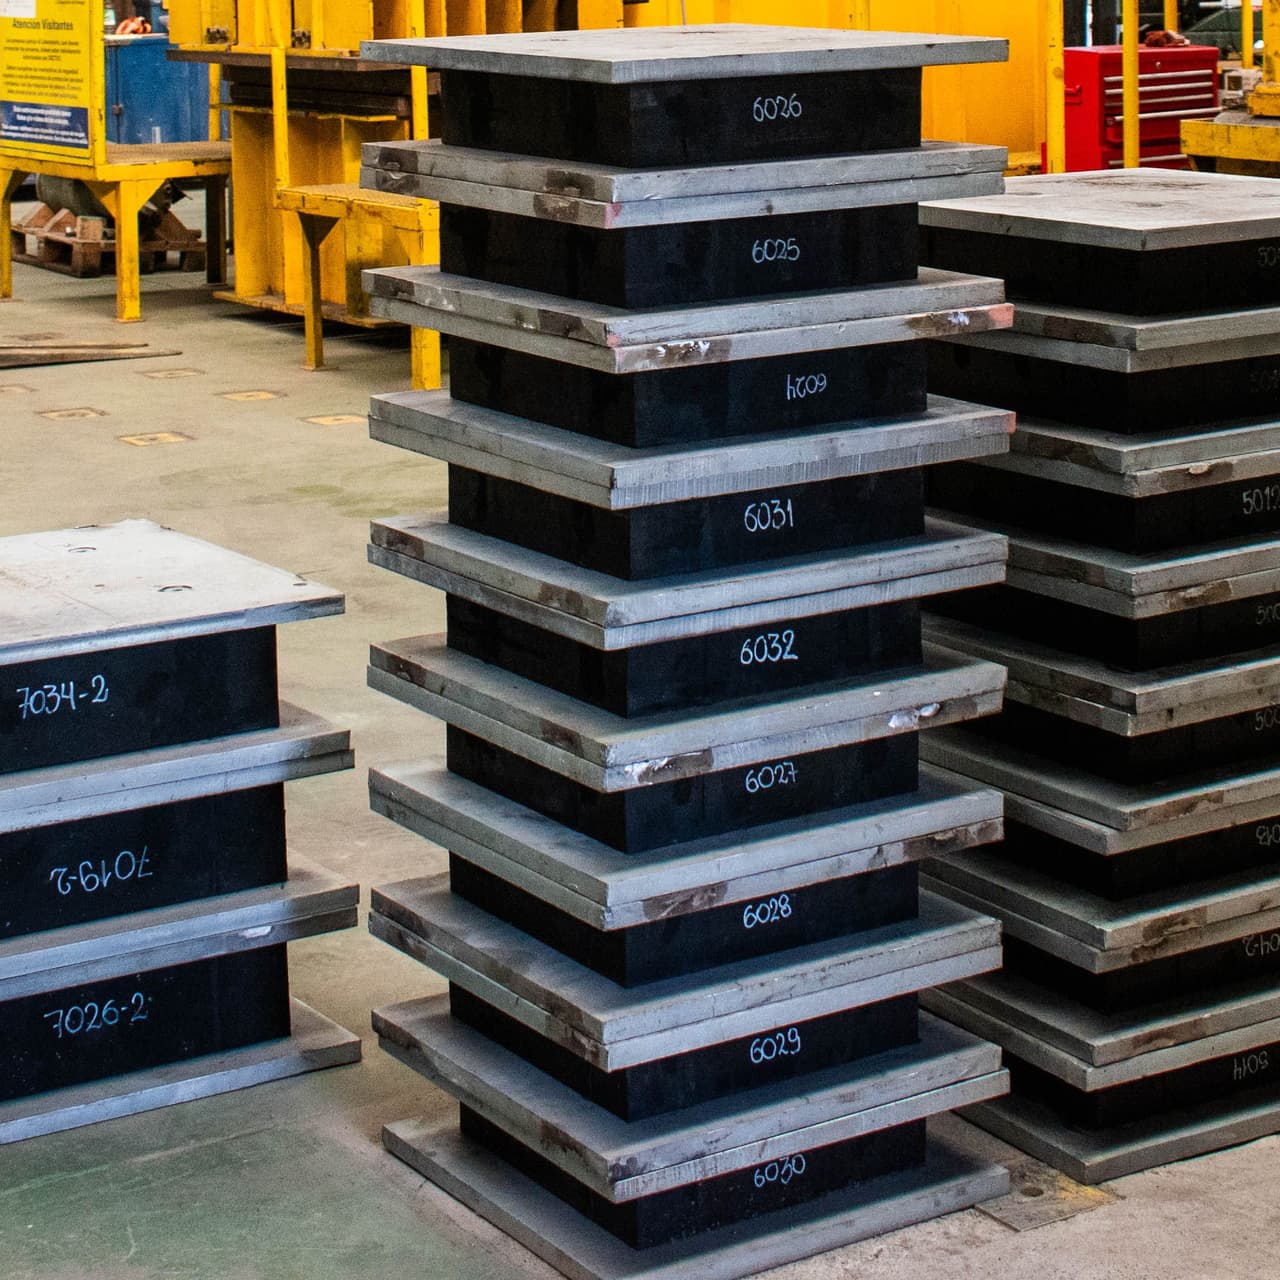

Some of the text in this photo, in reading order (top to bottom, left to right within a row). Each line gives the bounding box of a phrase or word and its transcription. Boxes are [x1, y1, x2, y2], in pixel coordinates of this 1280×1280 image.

[753, 93, 803, 122] 6026
[752, 238, 800, 263] 6025
[786, 373, 827, 401] 6024
[744, 498, 793, 532] 6031
[740, 630, 799, 665] 6032
[16, 674, 109, 719] 7034-2
[745, 762, 799, 793] 6027
[743, 894, 792, 928] 6028
[43, 992, 148, 1039] 7026-2
[750, 1027, 801, 1063] 6029
[1233, 1050, 1269, 1080] 5014
[753, 1154, 806, 1187] 6030
